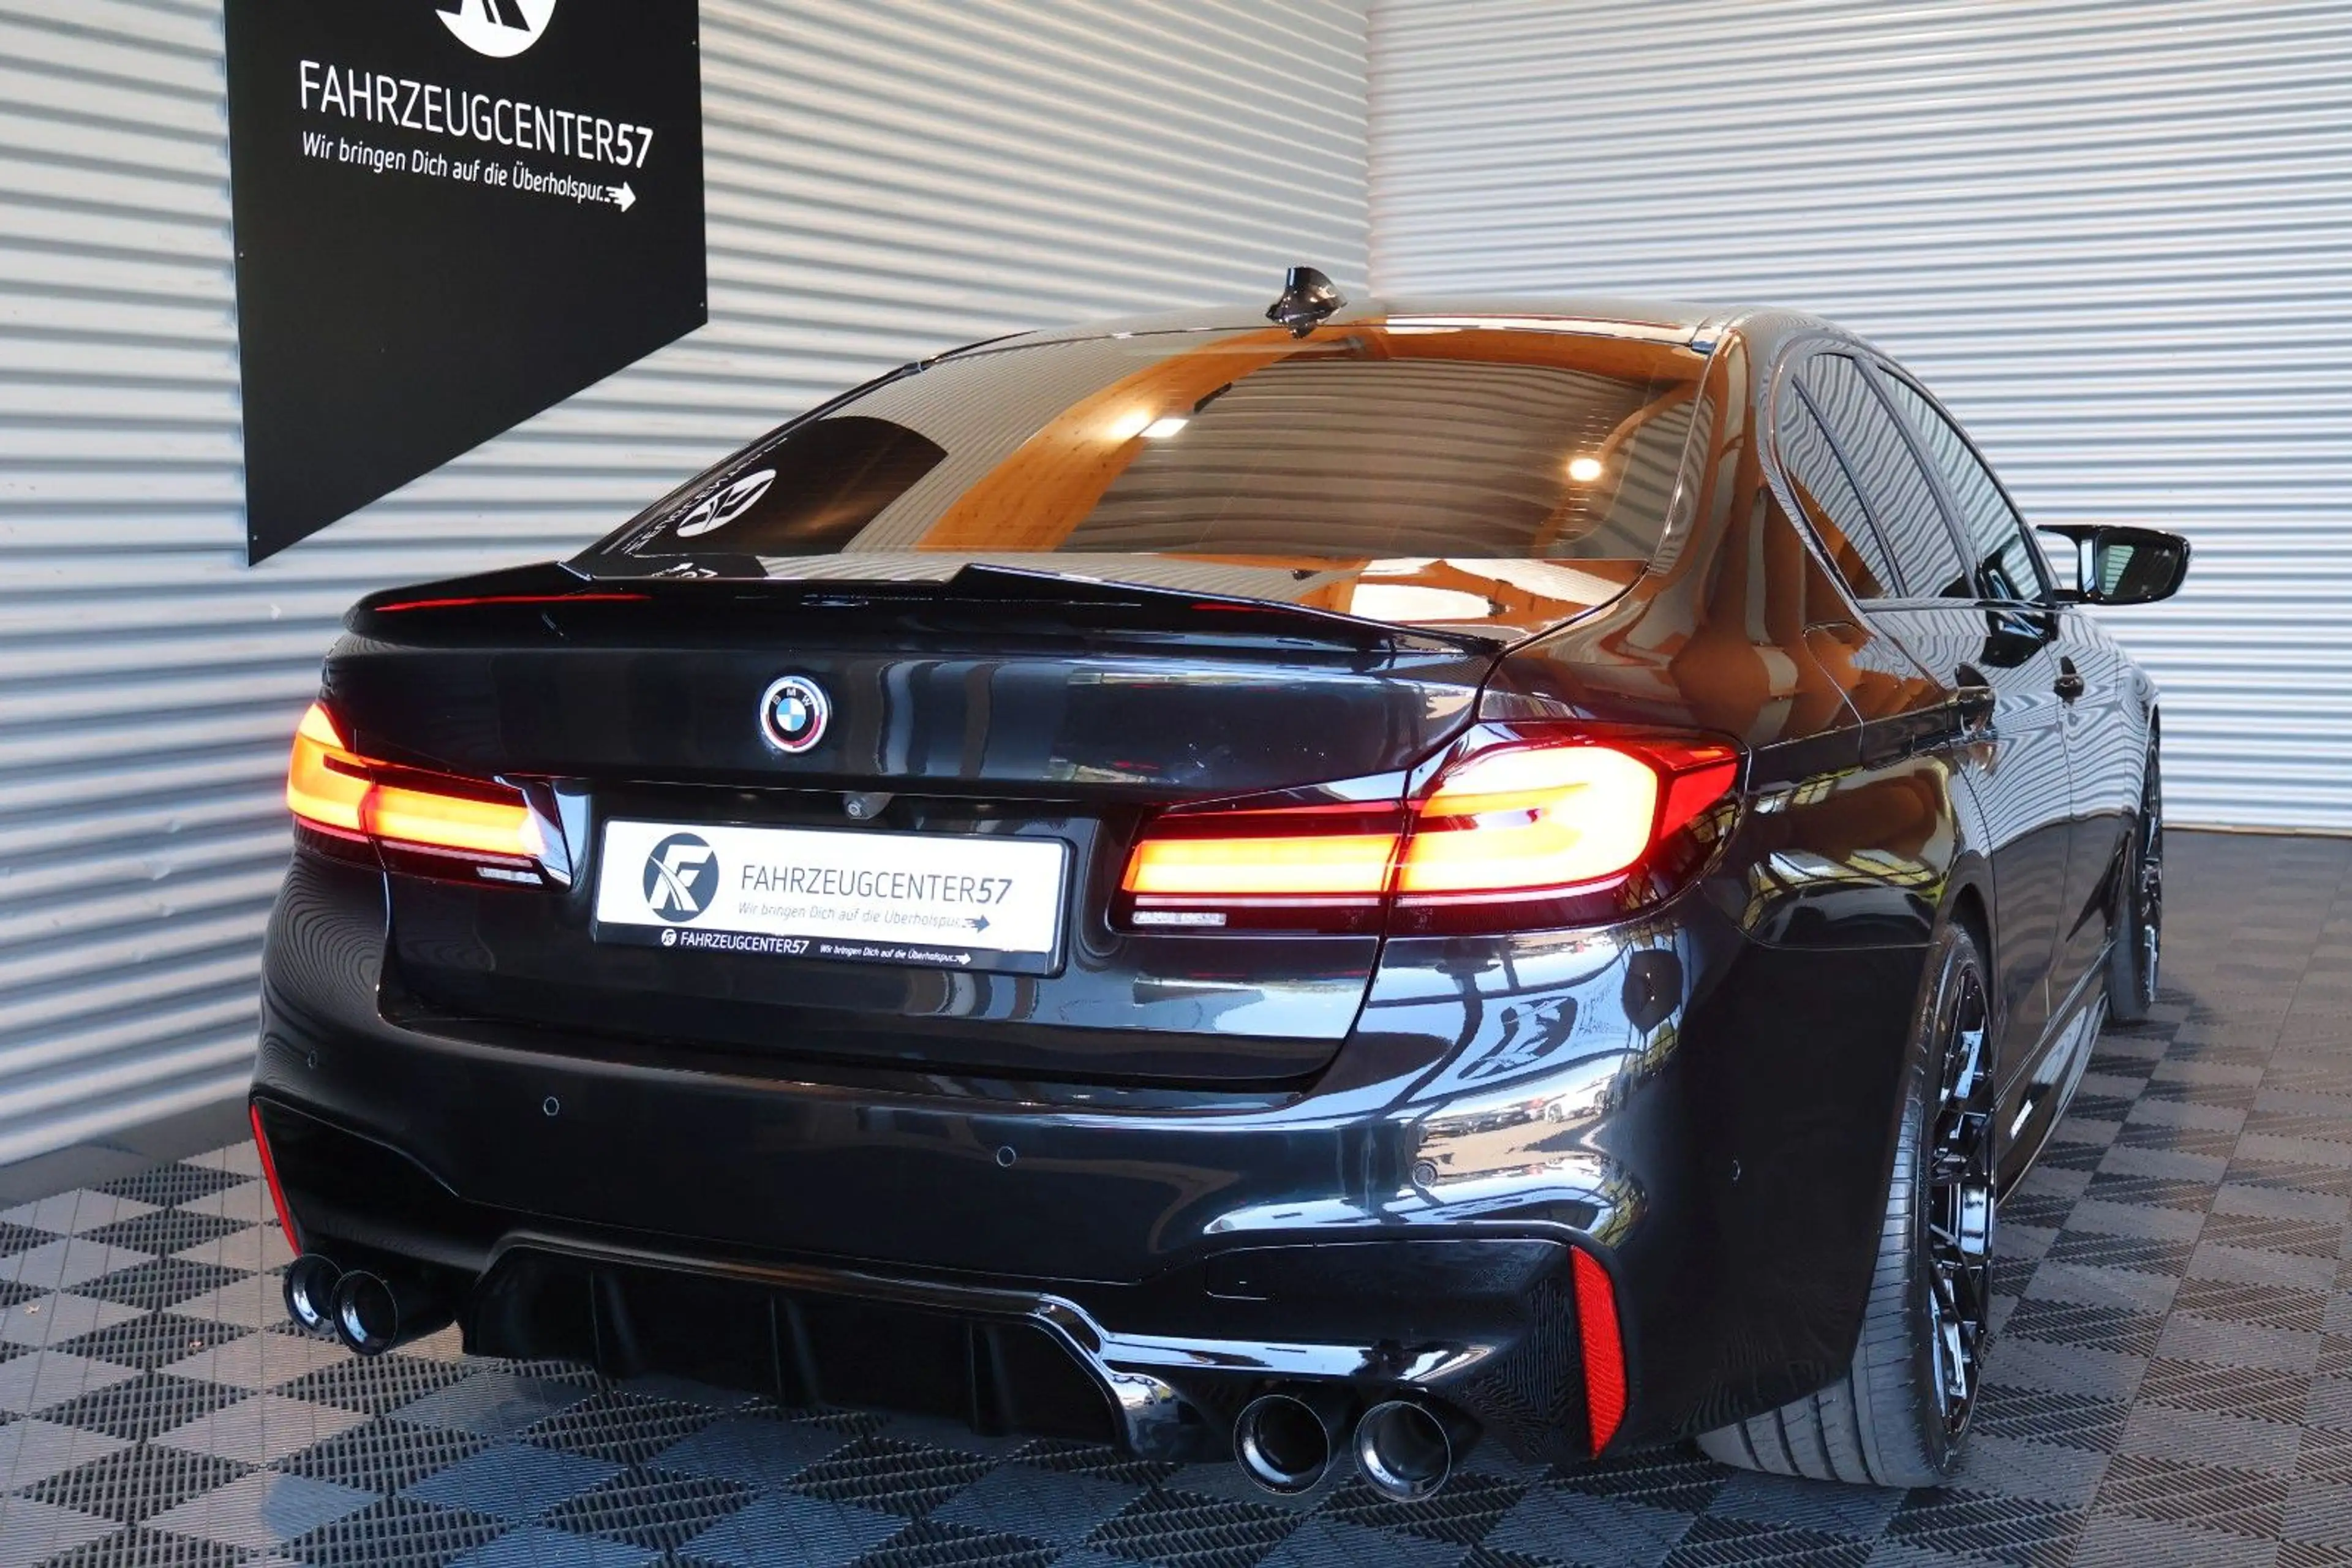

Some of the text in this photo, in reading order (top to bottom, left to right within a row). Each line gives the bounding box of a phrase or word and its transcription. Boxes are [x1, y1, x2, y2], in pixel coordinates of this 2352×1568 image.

[300, 60, 654, 169] FAHRZEUGCENTER57
[303, 130, 334, 159] Wir
[339, 137, 405, 173] bringen
[411, 149, 448, 177] Dich
[452, 159, 481, 181] auf
[484, 162, 508, 186] die
[772, 688, 812, 706] BMW
[741, 865, 1013, 905] FAHRZEUGCENTER57
[739, 902, 758, 914] Wir
[761, 903, 806, 921] bringen
[810, 905, 835, 920] Dich
[838, 908, 860, 921] auf
[862, 910, 880, 923] die
[680, 931, 810, 954] FAHRZEUGCENTER57
